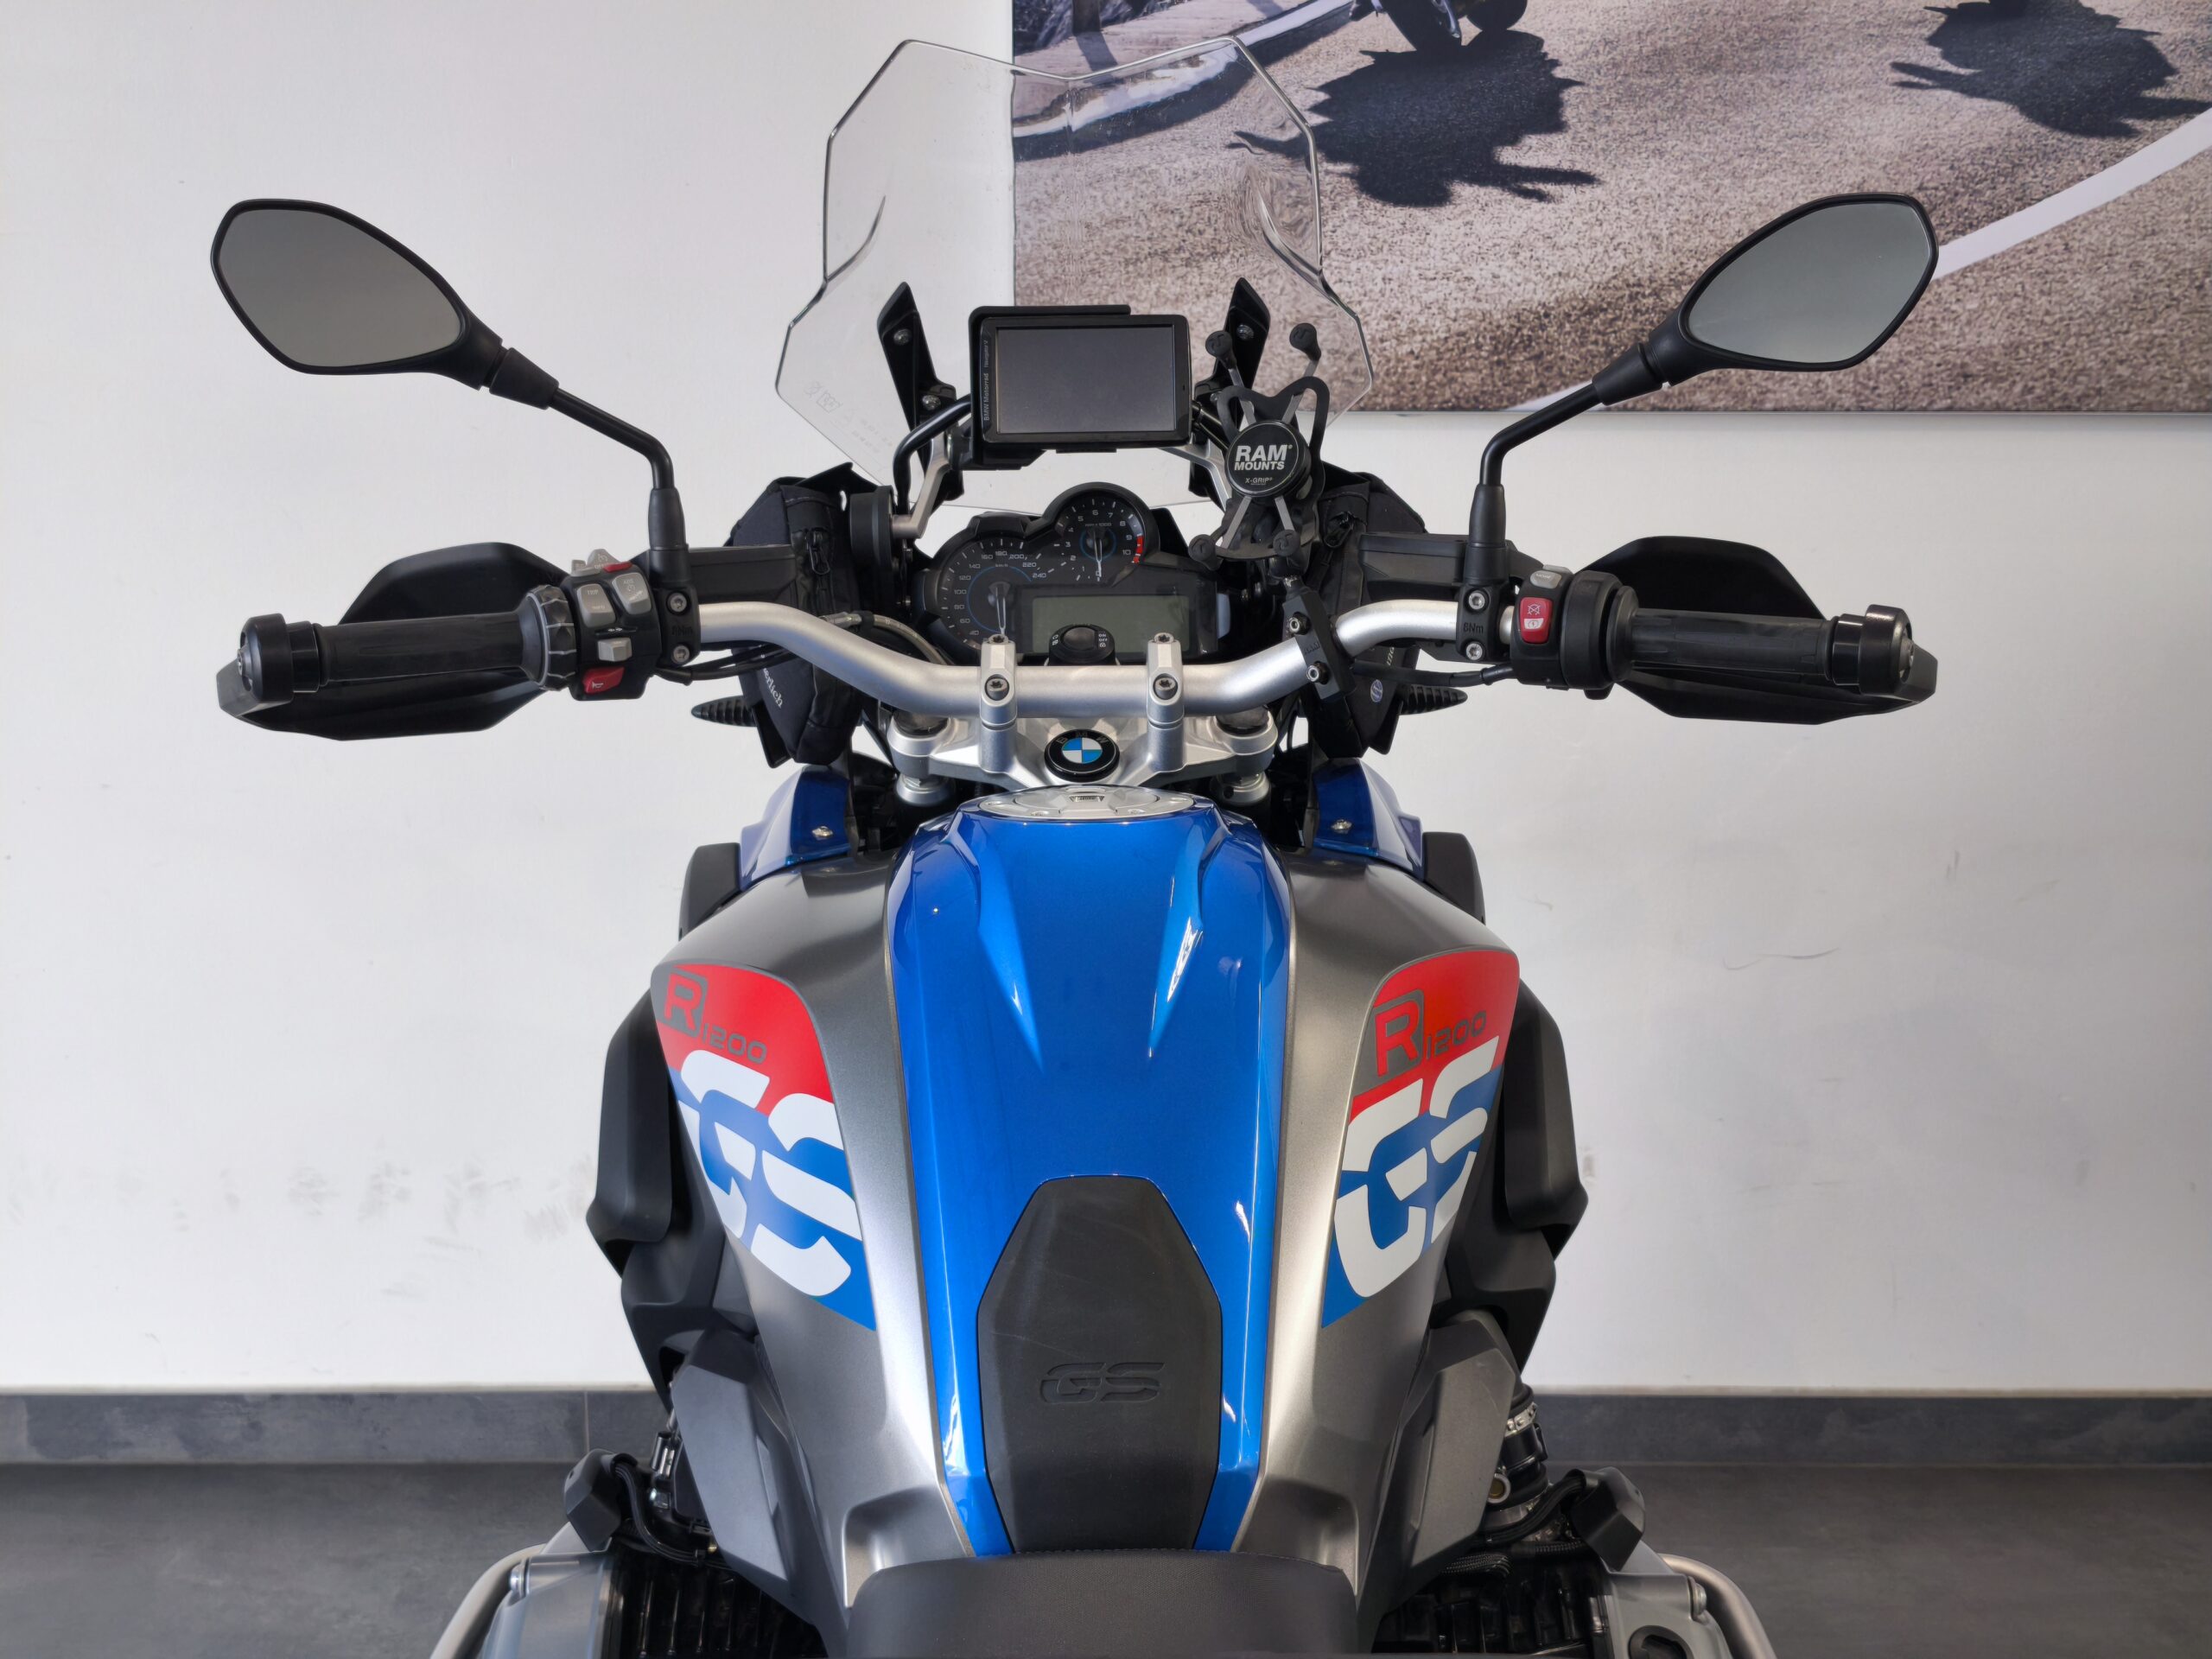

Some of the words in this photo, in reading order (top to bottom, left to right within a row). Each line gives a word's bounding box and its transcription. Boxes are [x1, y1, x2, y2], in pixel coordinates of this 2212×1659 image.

[1234, 461, 1285, 471] MOUNTS
[1236, 444, 1288, 461] RAM
[1056, 731, 1110, 744] BMW
[664, 972, 702, 1028] R
[701, 1021, 767, 1064] 1200
[1375, 1000, 1420, 1077] R
[1425, 1010, 1486, 1060] 1200
[678, 1049, 863, 1296] GS
[1334, 1035, 1500, 1297] GS
[1039, 1362, 1166, 1404] GS
